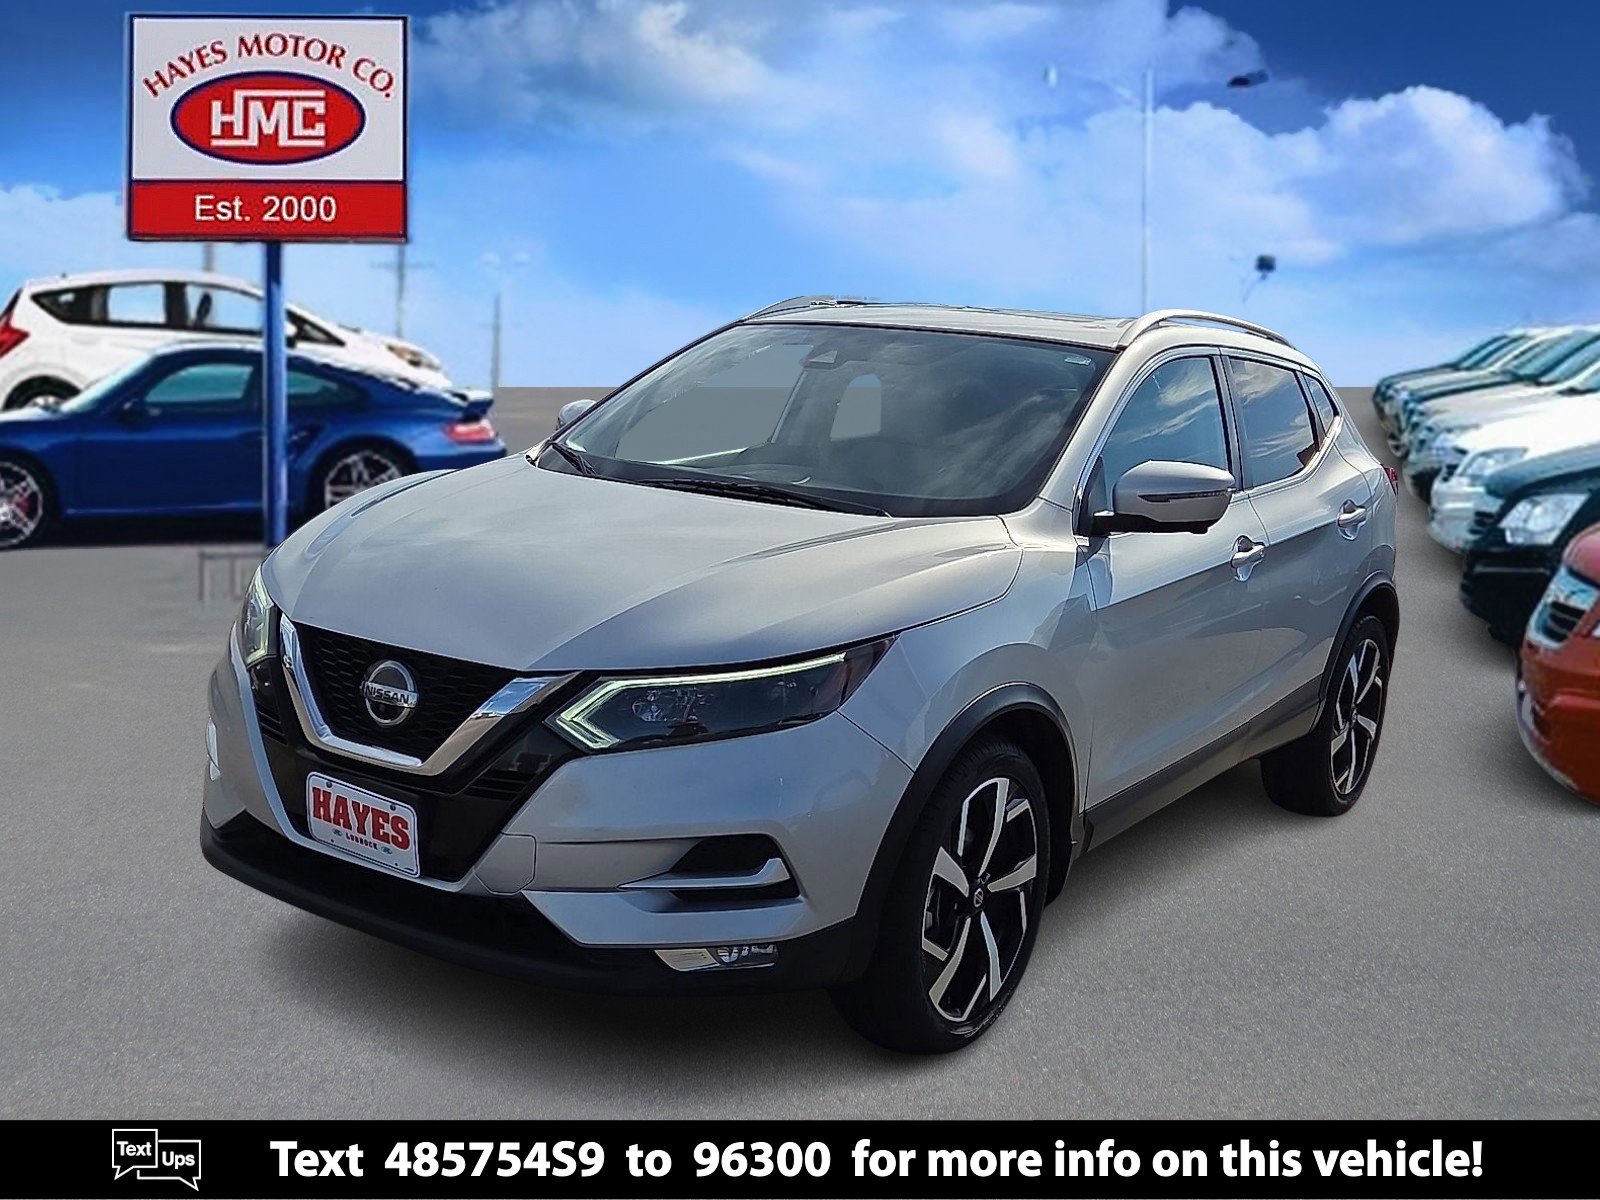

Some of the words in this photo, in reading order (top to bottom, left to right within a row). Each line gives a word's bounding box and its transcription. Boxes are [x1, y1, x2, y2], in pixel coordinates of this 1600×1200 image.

[142, 40, 227, 97] HAYES
[237, 33, 346, 69] MOTOR
[352, 57, 395, 99] CO.
[210, 89, 326, 147] HMC
[194, 194, 250, 222] Est.
[262, 195, 337, 222] 2000
[365, 685, 410, 704] NISSAN
[312, 787, 410, 850] HAYES
